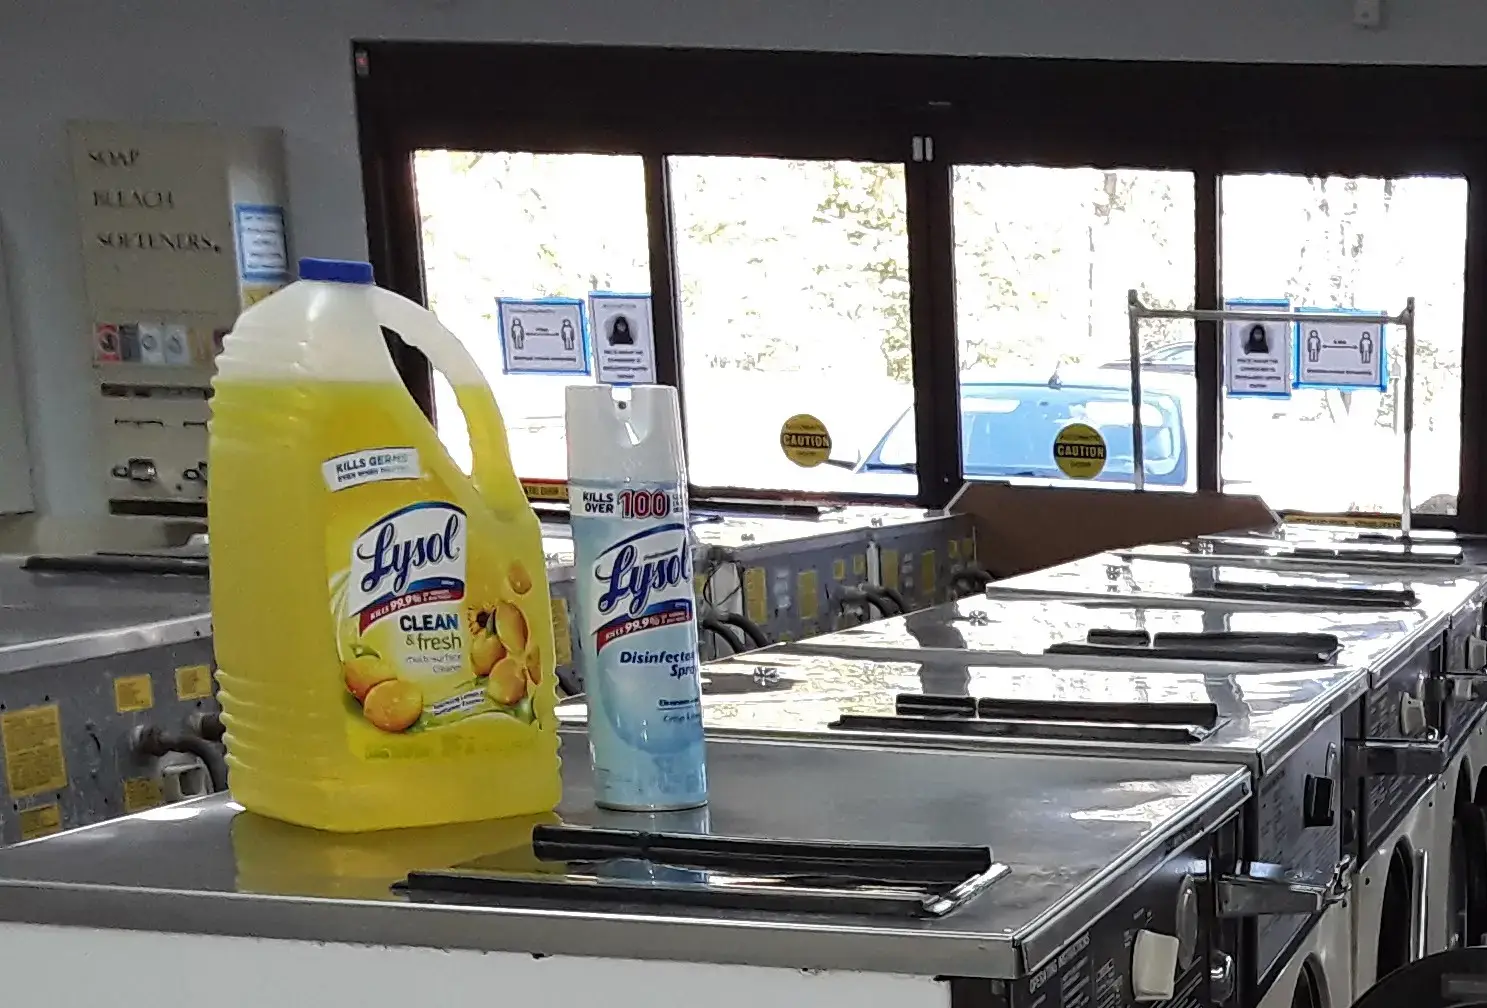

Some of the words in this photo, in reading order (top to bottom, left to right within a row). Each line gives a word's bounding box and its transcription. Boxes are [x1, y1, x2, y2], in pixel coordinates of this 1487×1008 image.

[93, 188, 175, 210] BLEACH
[783, 434, 829, 448] CAUTION
[1057, 444, 1104, 459] CAUTION
[336, 457, 367, 473] KILLS
[583, 490, 614, 503] KILLS
[617, 488, 670, 520] 100
[584, 502, 614, 514] OVER
[357, 513, 461, 593] Lysol
[595, 537, 689, 616] Lysol
[399, 613, 459, 632] CLEAN
[405, 634, 415, 646] &
[417, 632, 462, 651] fresh
